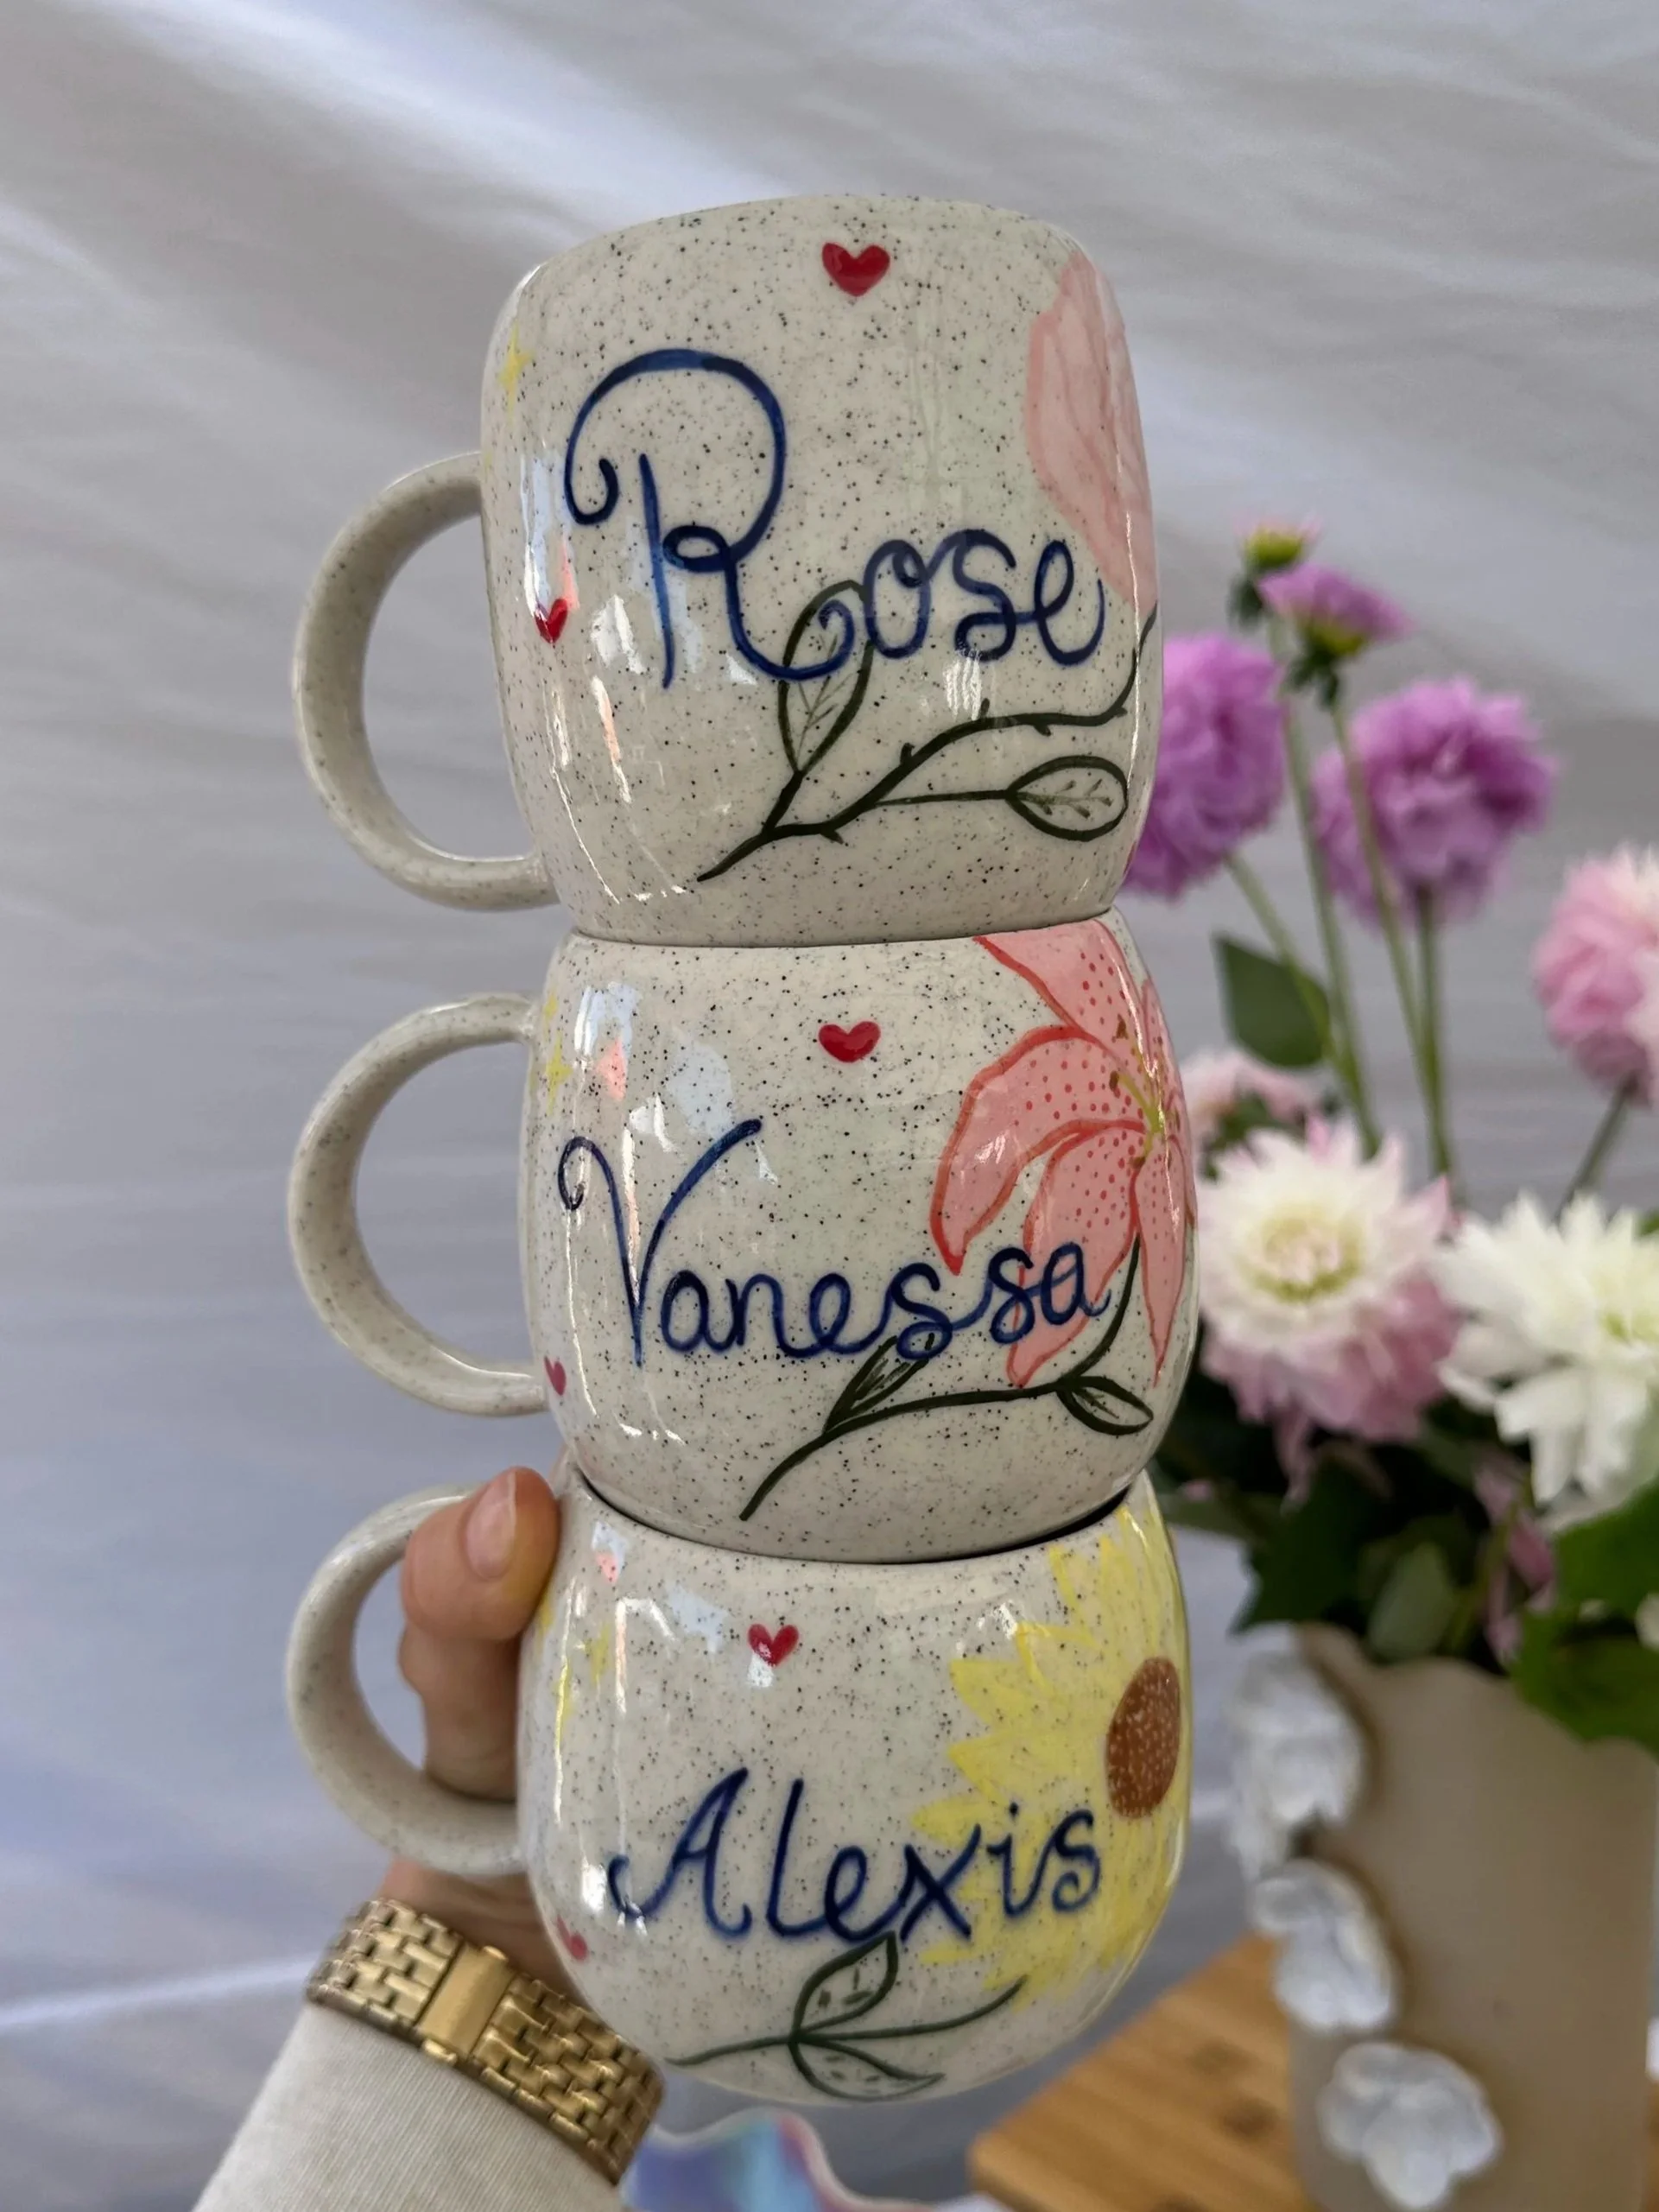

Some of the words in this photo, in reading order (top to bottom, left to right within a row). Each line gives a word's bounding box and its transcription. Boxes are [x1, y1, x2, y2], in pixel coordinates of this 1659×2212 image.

[563, 347, 1105, 688] Rose
[558, 1118, 1111, 1367] Vanessa
[606, 1766, 1101, 1943] Alexis
